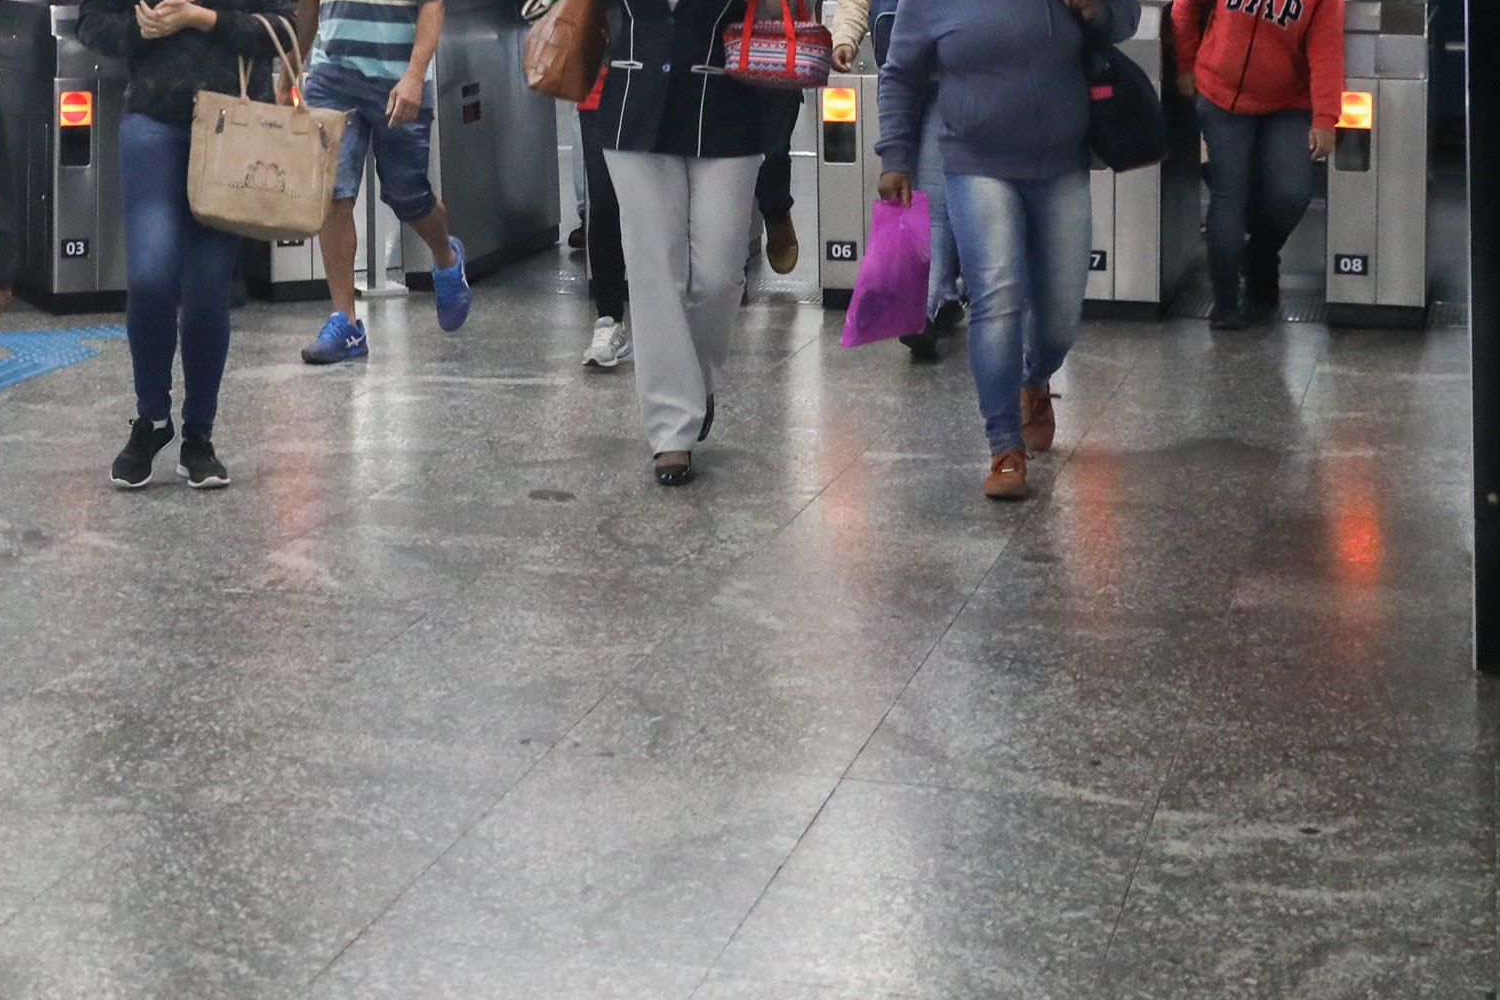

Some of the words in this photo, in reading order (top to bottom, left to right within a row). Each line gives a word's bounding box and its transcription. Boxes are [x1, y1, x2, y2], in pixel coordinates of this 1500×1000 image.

[66, 241, 85, 256] 03
[831, 244, 852, 258] 06
[1340, 257, 1363, 272] 08
